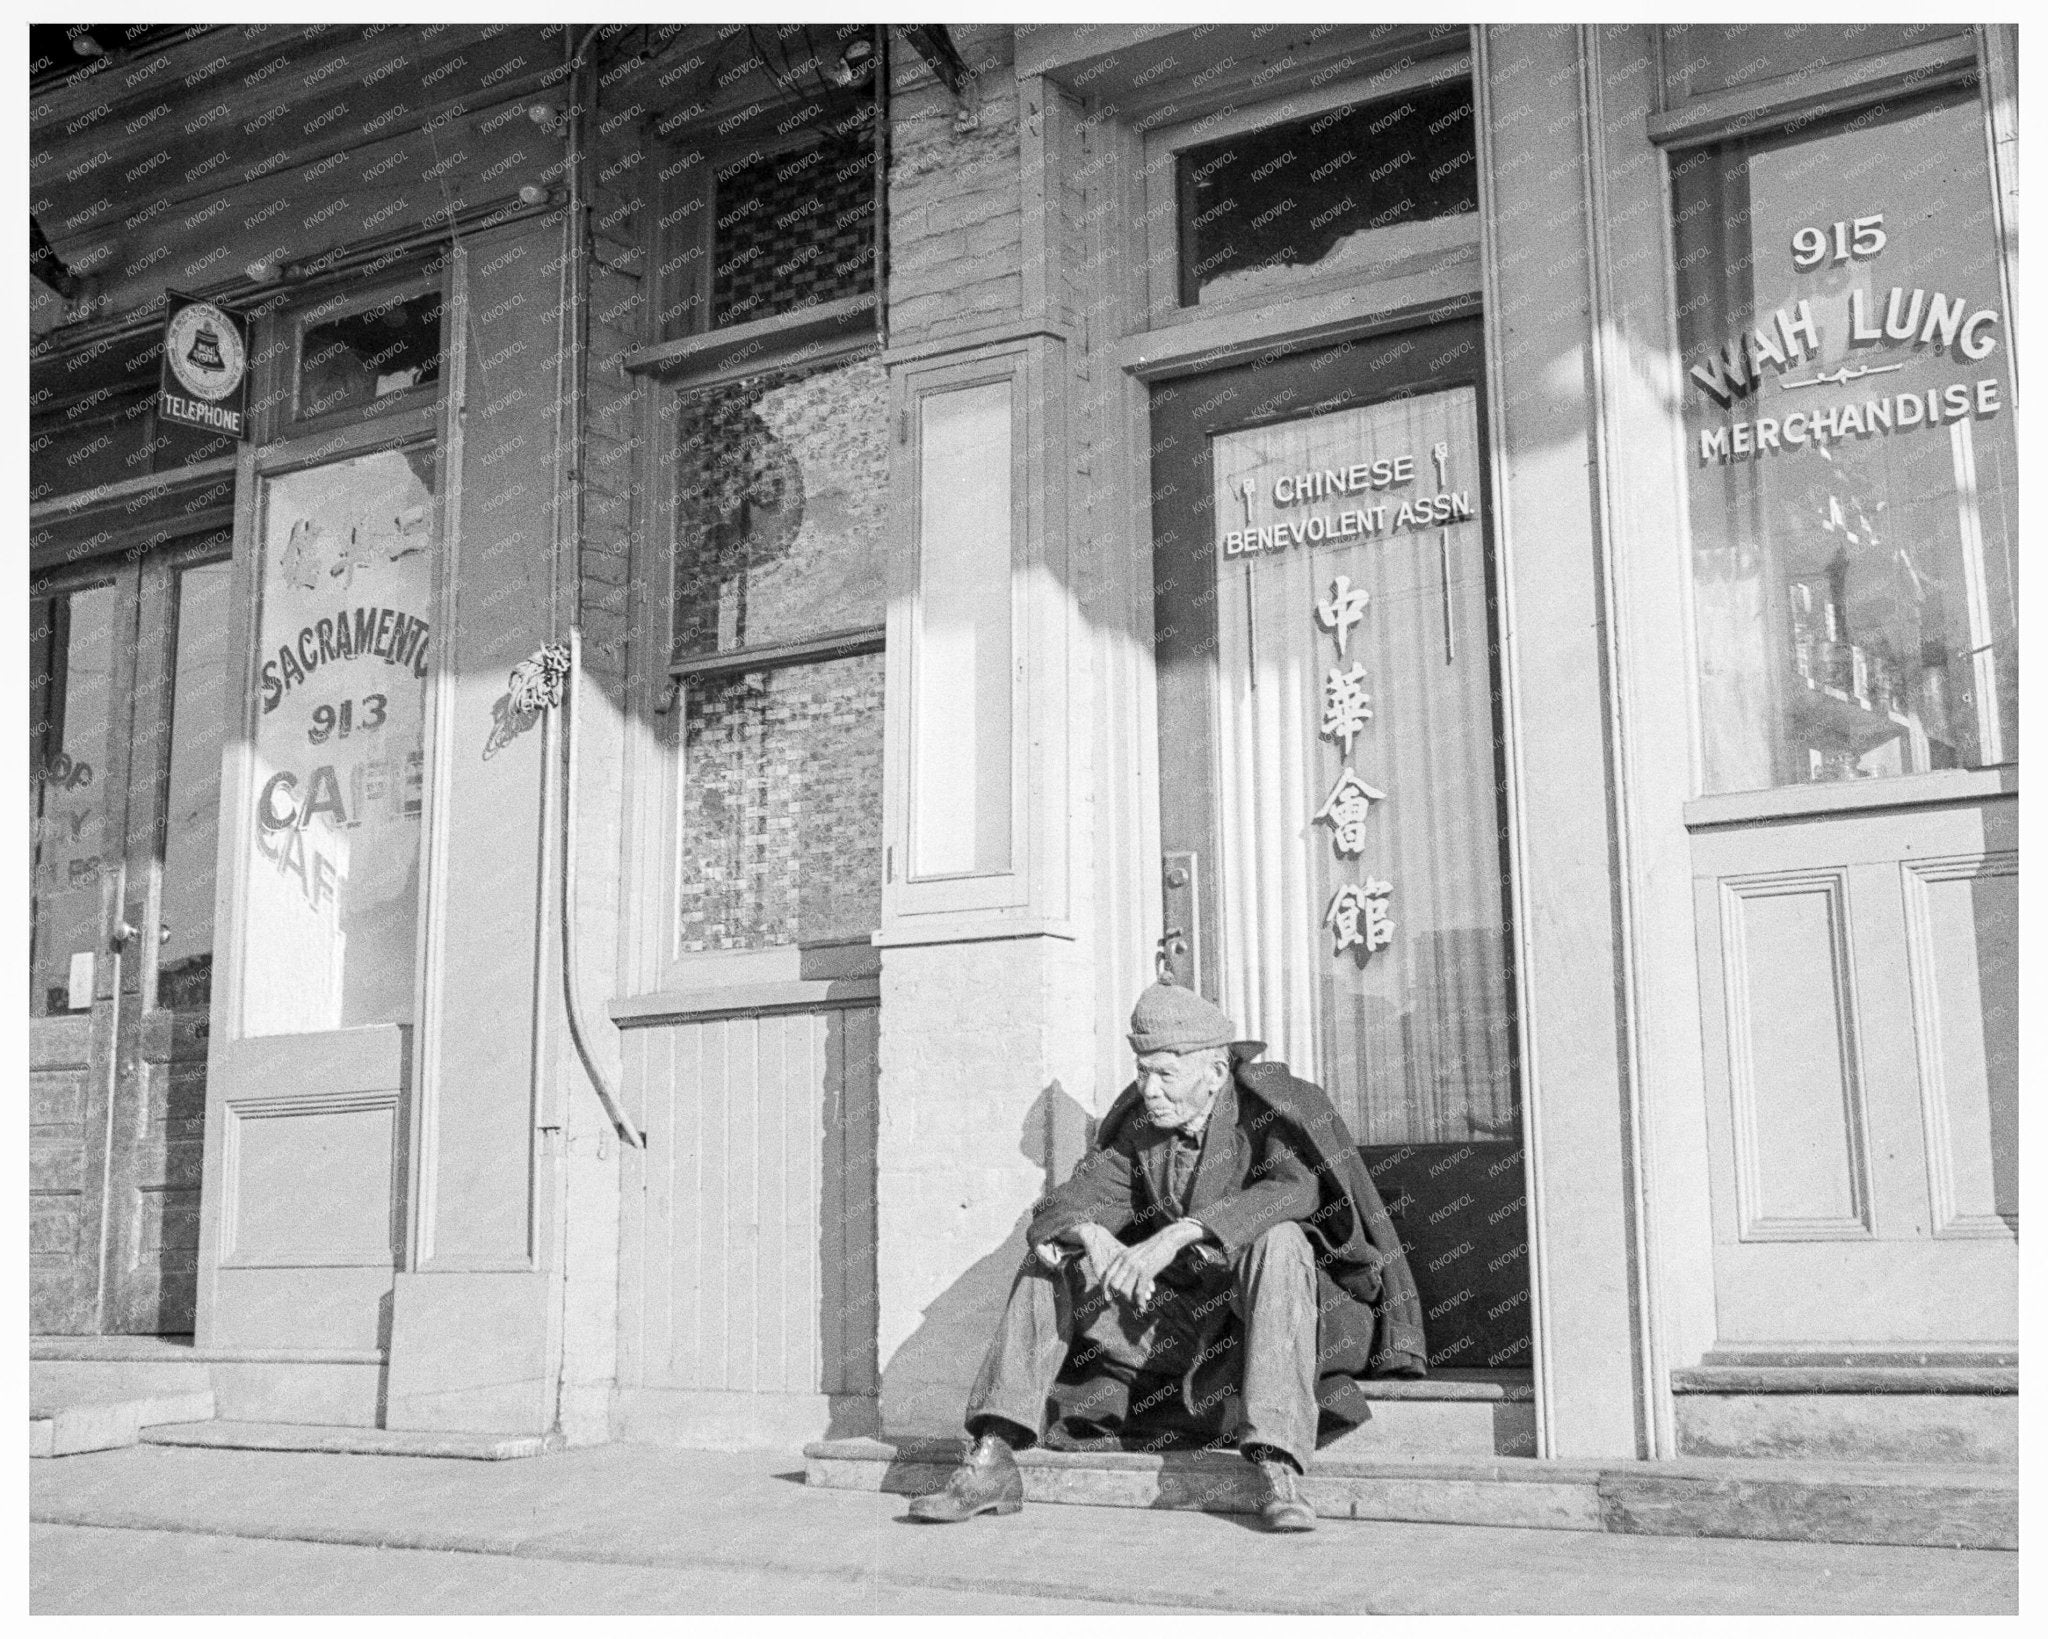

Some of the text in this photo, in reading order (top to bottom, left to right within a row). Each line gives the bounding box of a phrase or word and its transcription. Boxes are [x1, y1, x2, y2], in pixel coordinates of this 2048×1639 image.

[1792, 214, 1887, 266] 915
[1689, 287, 1998, 401] WAH LUNG
[165, 395, 241, 432] TELEPHONE
[1700, 379, 2001, 459] MERCHANDISE
[1275, 455, 1415, 502] CHINESE
[1226, 491, 1476, 554] BENEVOLENT ASSN.
[308, 694, 387, 745] 913
